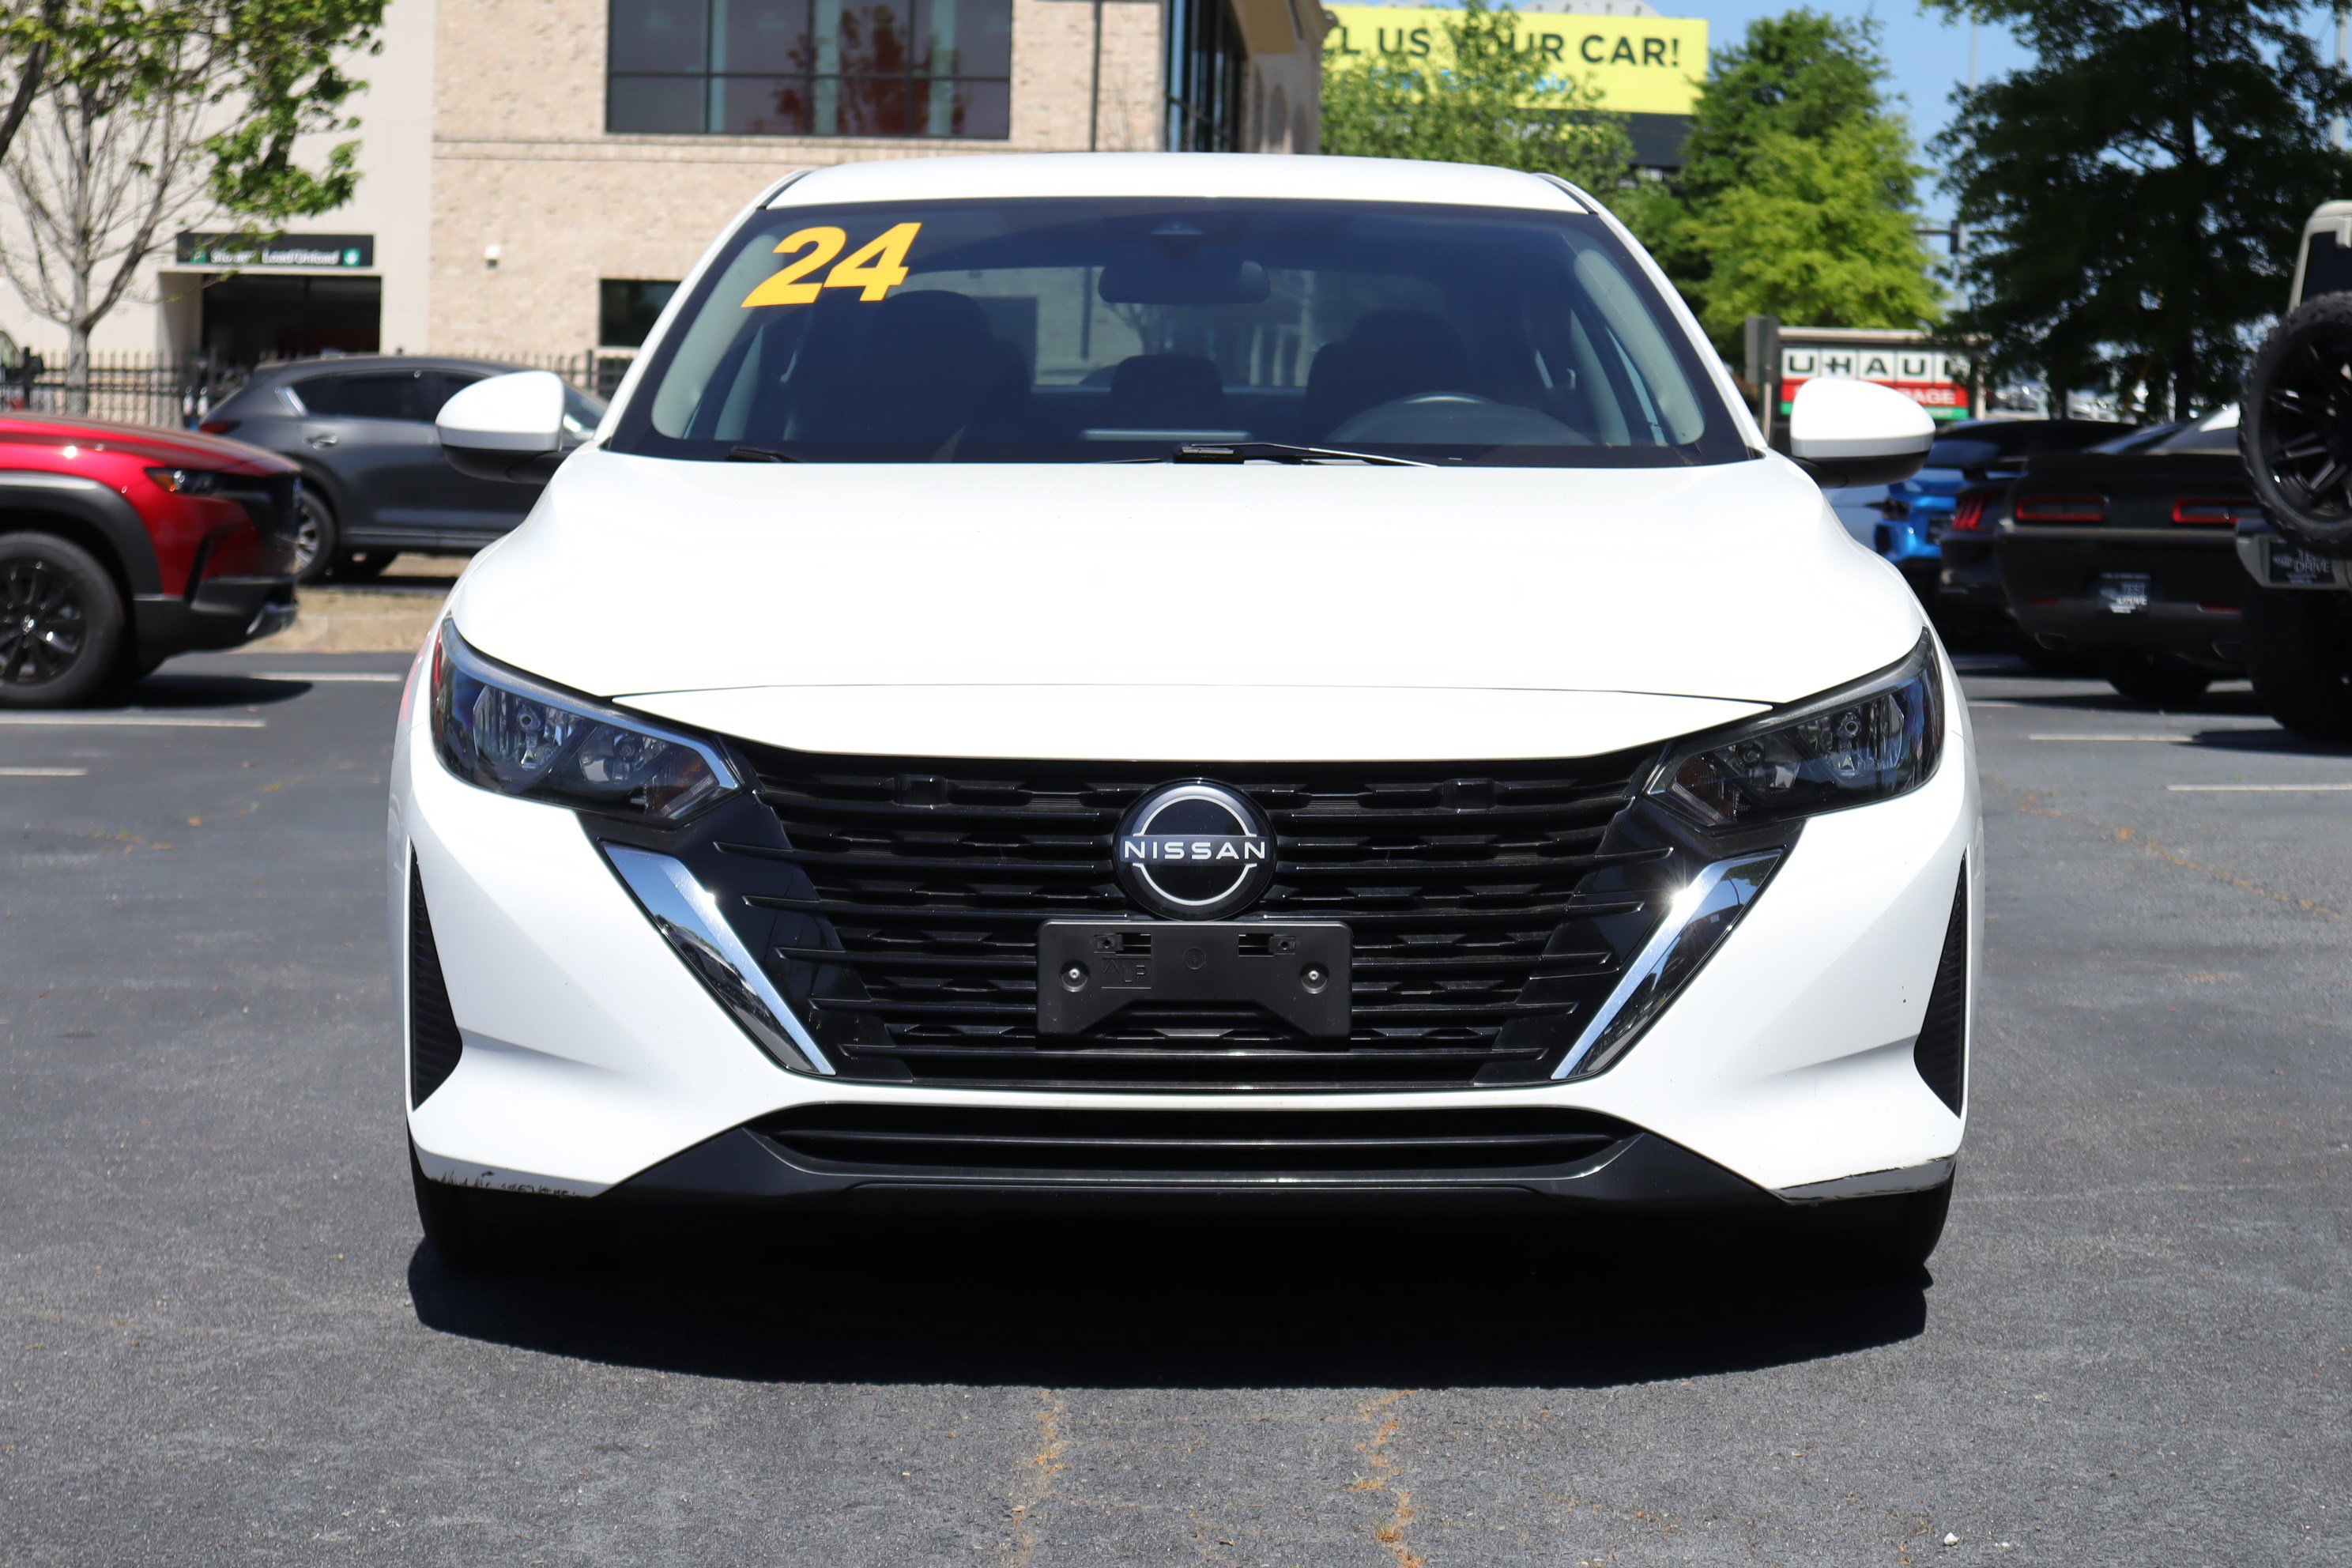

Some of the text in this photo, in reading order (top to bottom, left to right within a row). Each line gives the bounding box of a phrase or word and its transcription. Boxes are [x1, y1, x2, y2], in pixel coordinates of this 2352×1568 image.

[1377, 28, 1431, 56] US
[1581, 34, 1679, 66] CAR!
[741, 222, 922, 307] 24
[1124, 840, 1265, 860] NISSAN
